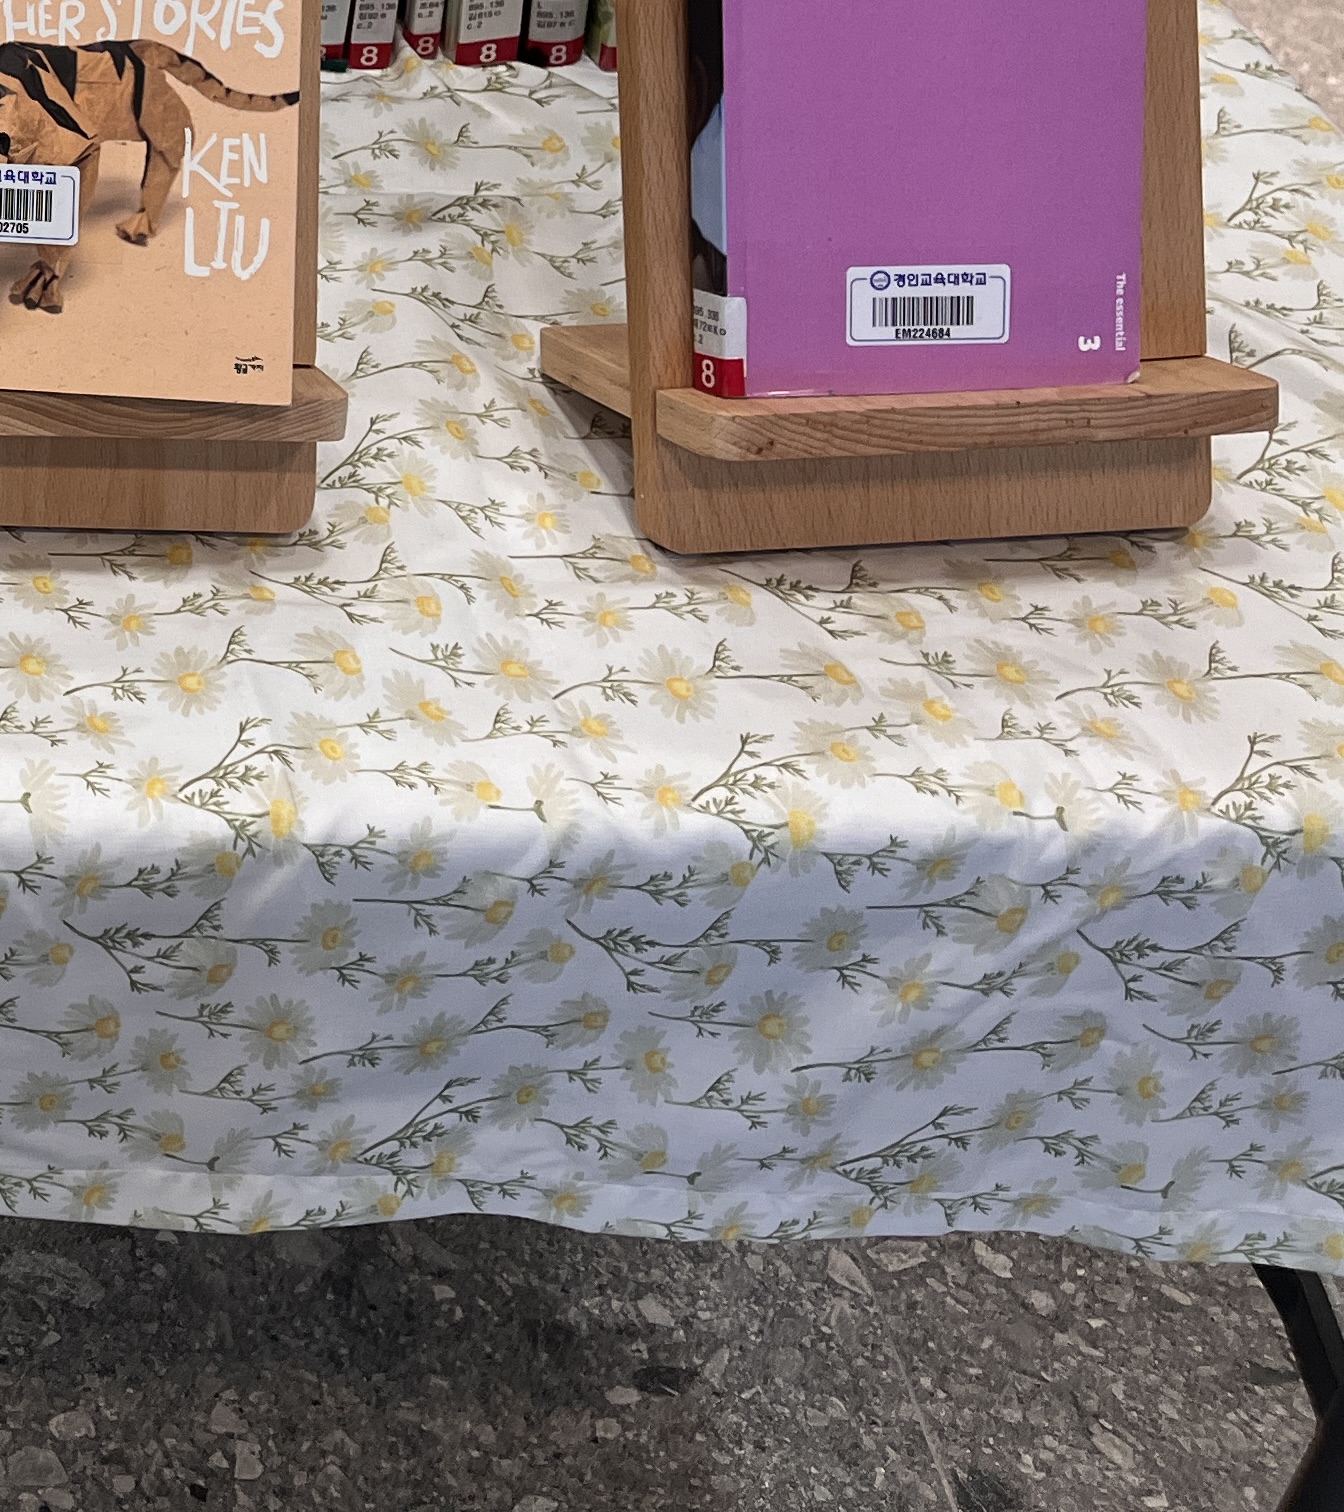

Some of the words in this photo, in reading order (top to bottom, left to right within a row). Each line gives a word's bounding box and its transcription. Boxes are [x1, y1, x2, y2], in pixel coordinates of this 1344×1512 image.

[361, 45, 379, 66] 8
[417, 37, 435, 56] 8
[480, 42, 498, 63] 8
[550, 44, 568, 65] 8
[181, 127, 269, 198] KEN
[184, 200, 271, 281] LIU
[892, 270, 989, 289] 경인교육대학교
[1114, 272, 1127, 297] The
[893, 327, 952, 341] EM224684
[1113, 298, 1127, 352] essential
[1078, 335, 1102, 352] 3
[700, 359, 716, 389] 8
